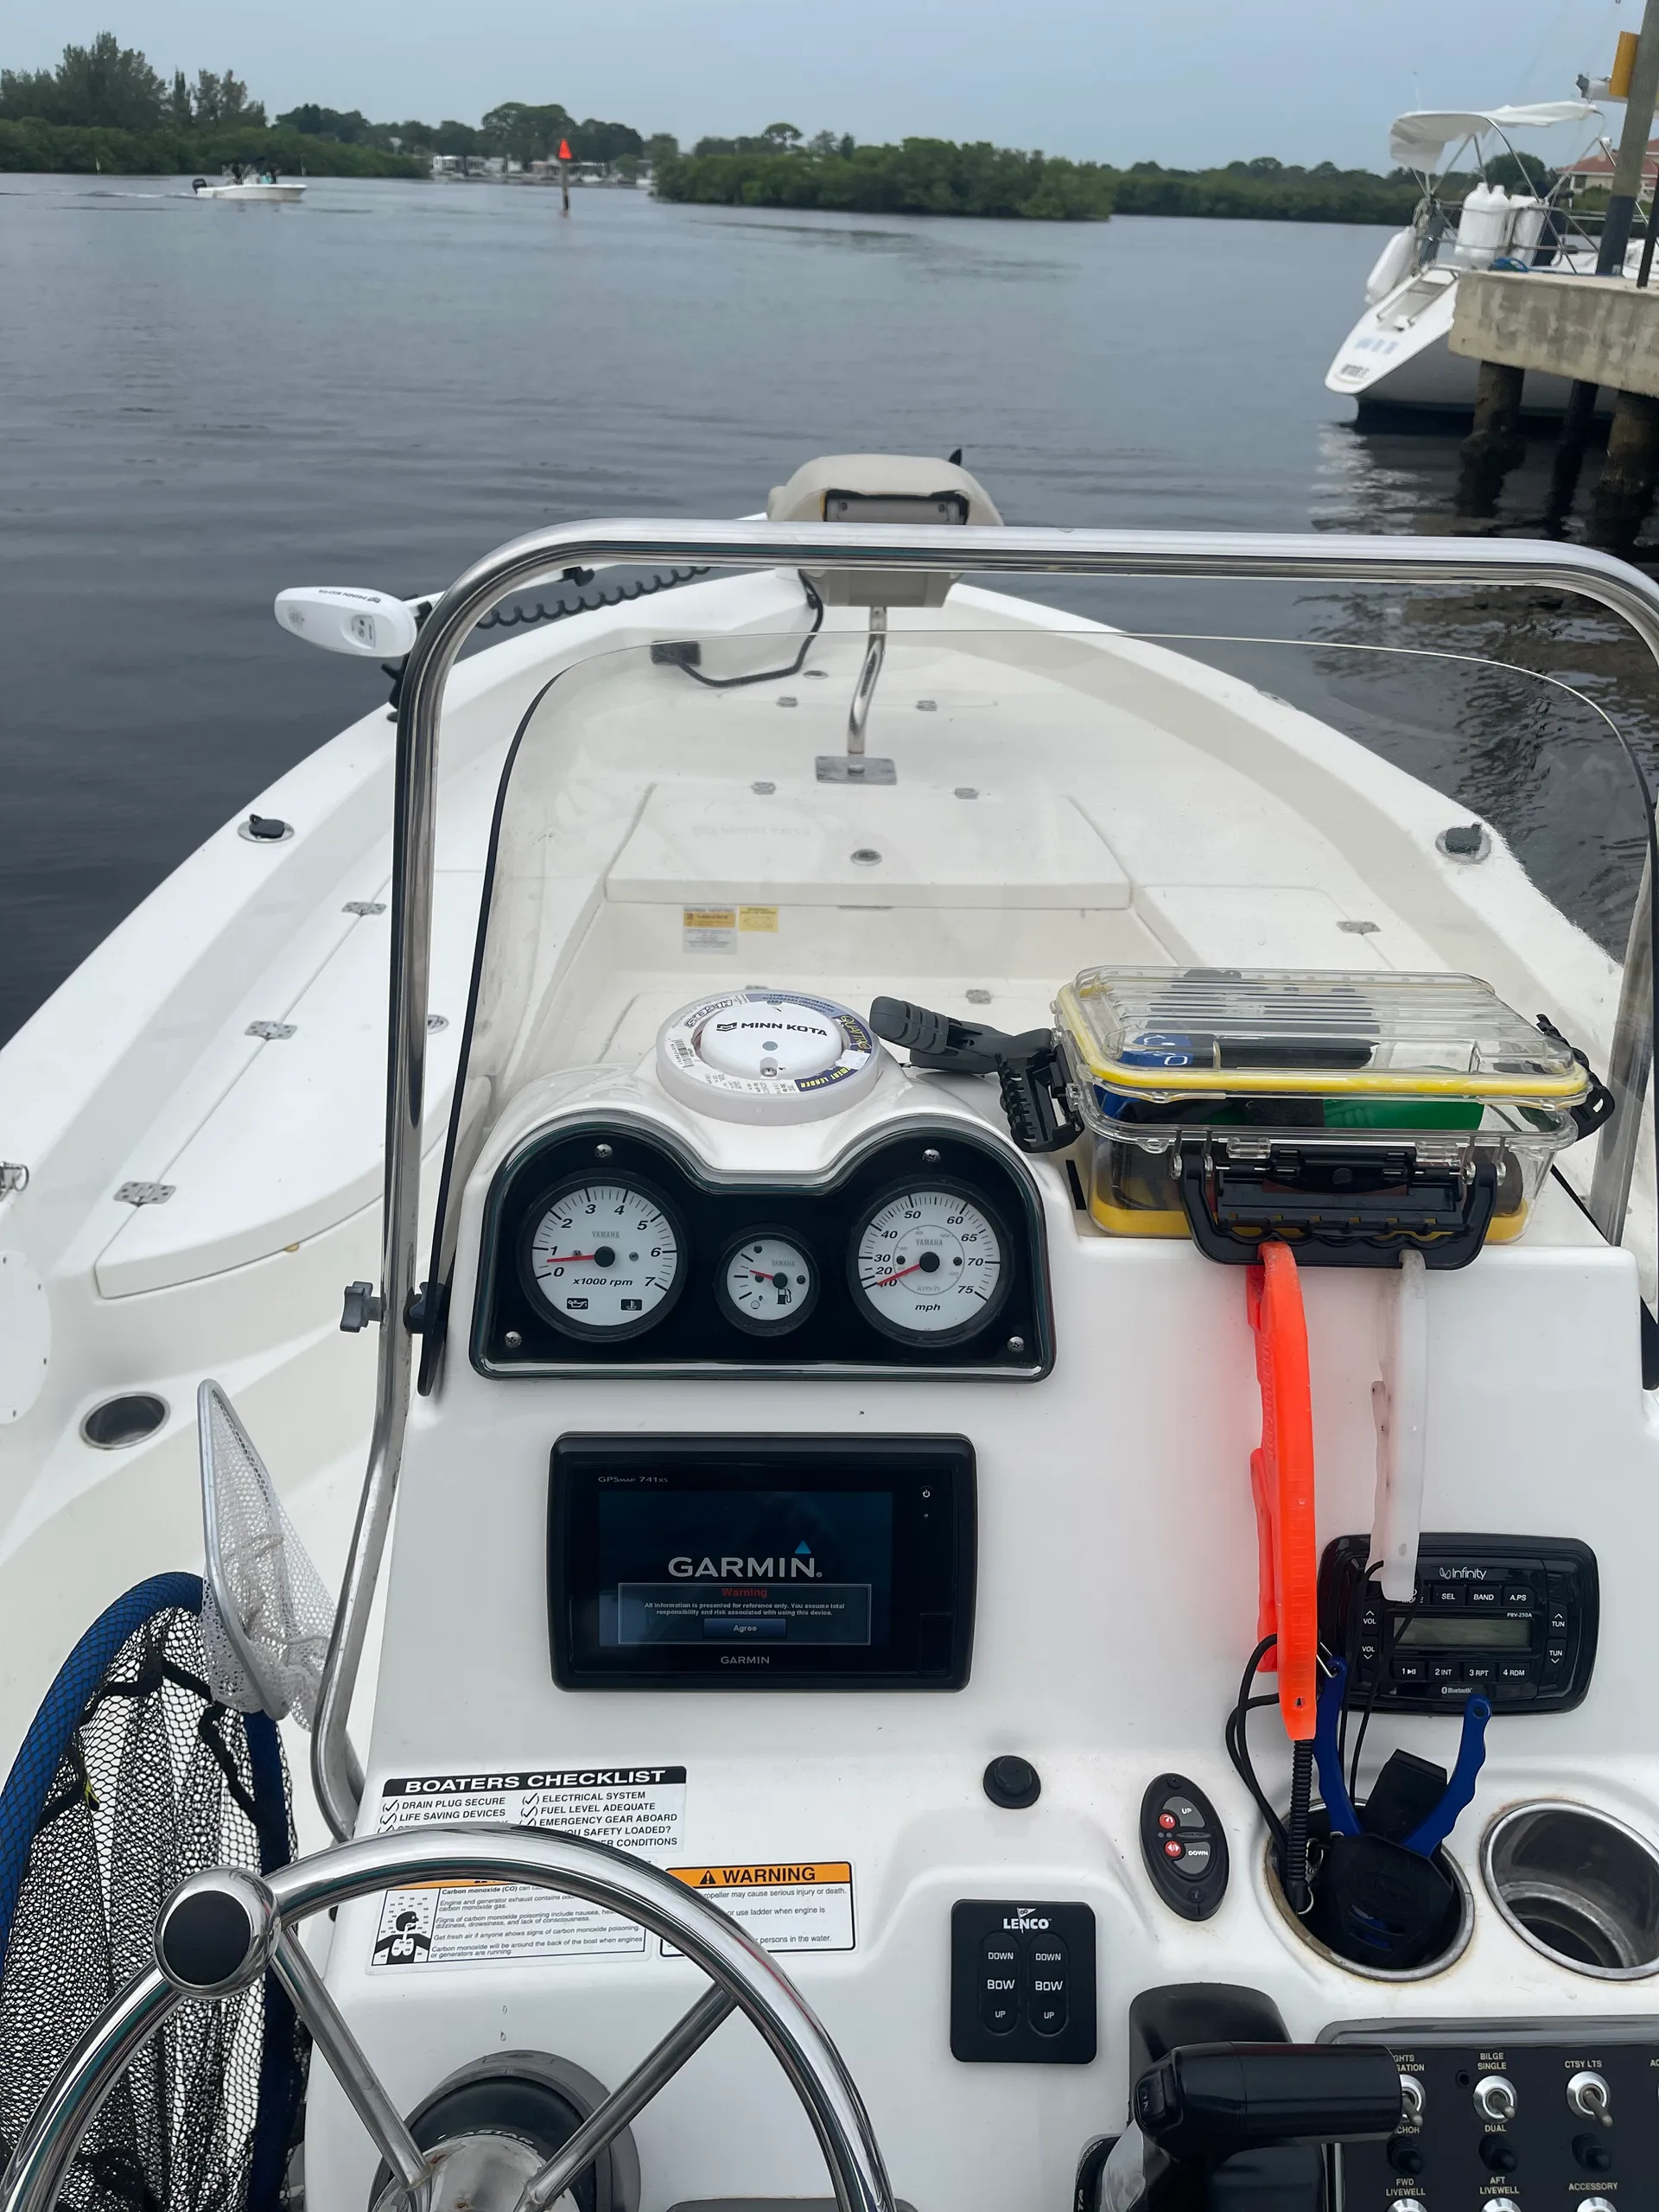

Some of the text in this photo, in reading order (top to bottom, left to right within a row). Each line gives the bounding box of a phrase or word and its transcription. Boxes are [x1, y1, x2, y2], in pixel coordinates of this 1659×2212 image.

[786, 1024, 828, 1037] KOTA
[800, 1077, 830, 1089] LEADER
[585, 1204, 596, 1215] 3
[614, 1205, 625, 1216] 4
[904, 1211, 921, 1219] 50
[946, 1216, 963, 1224] 60
[561, 1218, 573, 1229] 2
[637, 1220, 648, 1230] 5
[591, 1230, 620, 1239] YAMAHA
[880, 1230, 898, 1239] 40
[961, 1233, 978, 1242] 65
[915, 1238, 944, 1247] YAMAHA
[550, 1245, 558, 1255] 1
[651, 1247, 662, 1257] 6
[874, 1254, 891, 1262] 30
[967, 1258, 983, 1267] 70
[772, 1259, 795, 1268] YAMAHA
[553, 1267, 564, 1277] 0
[875, 1267, 893, 1275] 20
[573, 1277, 633, 1287] x1000 rpm
[645, 1276, 656, 1287] 7
[957, 1285, 975, 1294] 75
[915, 1303, 941, 1313] mph
[668, 1556, 815, 1578] GARMIN
[1452, 1567, 1487, 1580] Infinity
[721, 1588, 767, 1599] Warning
[733, 1624, 757, 1633] Agree
[720, 1656, 770, 1664] GARMIN
[404, 1770, 666, 1794] BOATERS CHECKLIST
[542, 1791, 645, 1802] ELECTRICAL SYSTEM
[402, 1797, 505, 1809] DRAIN PLUG SECURE
[540, 1802, 656, 1815] FUEL LEVEL ADEQUATE
[399, 1808, 505, 1821] LIFE SAVING DEVICES
[539, 1813, 677, 1827] EMERGENCY GEAR ABOARD
[583, 1827, 622, 1836] SAFETY
[625, 1825, 671, 1834] LOADED?
[616, 1837, 677, 1847] CONDITIONS
[722, 1866, 816, 1884] WARNING
[796, 1888, 816, 1897] injury
[794, 1907, 817, 1916] engine
[1003, 1918, 1050, 1929] LENCO
[438, 1950, 474, 1959] generators
[987, 1979, 1015, 1990] BOW
[1034, 1980, 1064, 1991] BOW
[1393, 2054, 1414, 2063] GHTS
[1480, 2052, 1504, 2061] BILGE
[1478, 2062, 1507, 2070] SINGLE
[1564, 2060, 1586, 2069] CTSY
[1395, 2126, 1420, 2134] CHOR
[1484, 2124, 1507, 2133] DUAL
[1479, 2186, 1520, 2195] LIVEWELL
[1568, 2182, 1618, 2191] ACCESSORY
[1386, 2188, 1426, 2196] LIVEWELL
